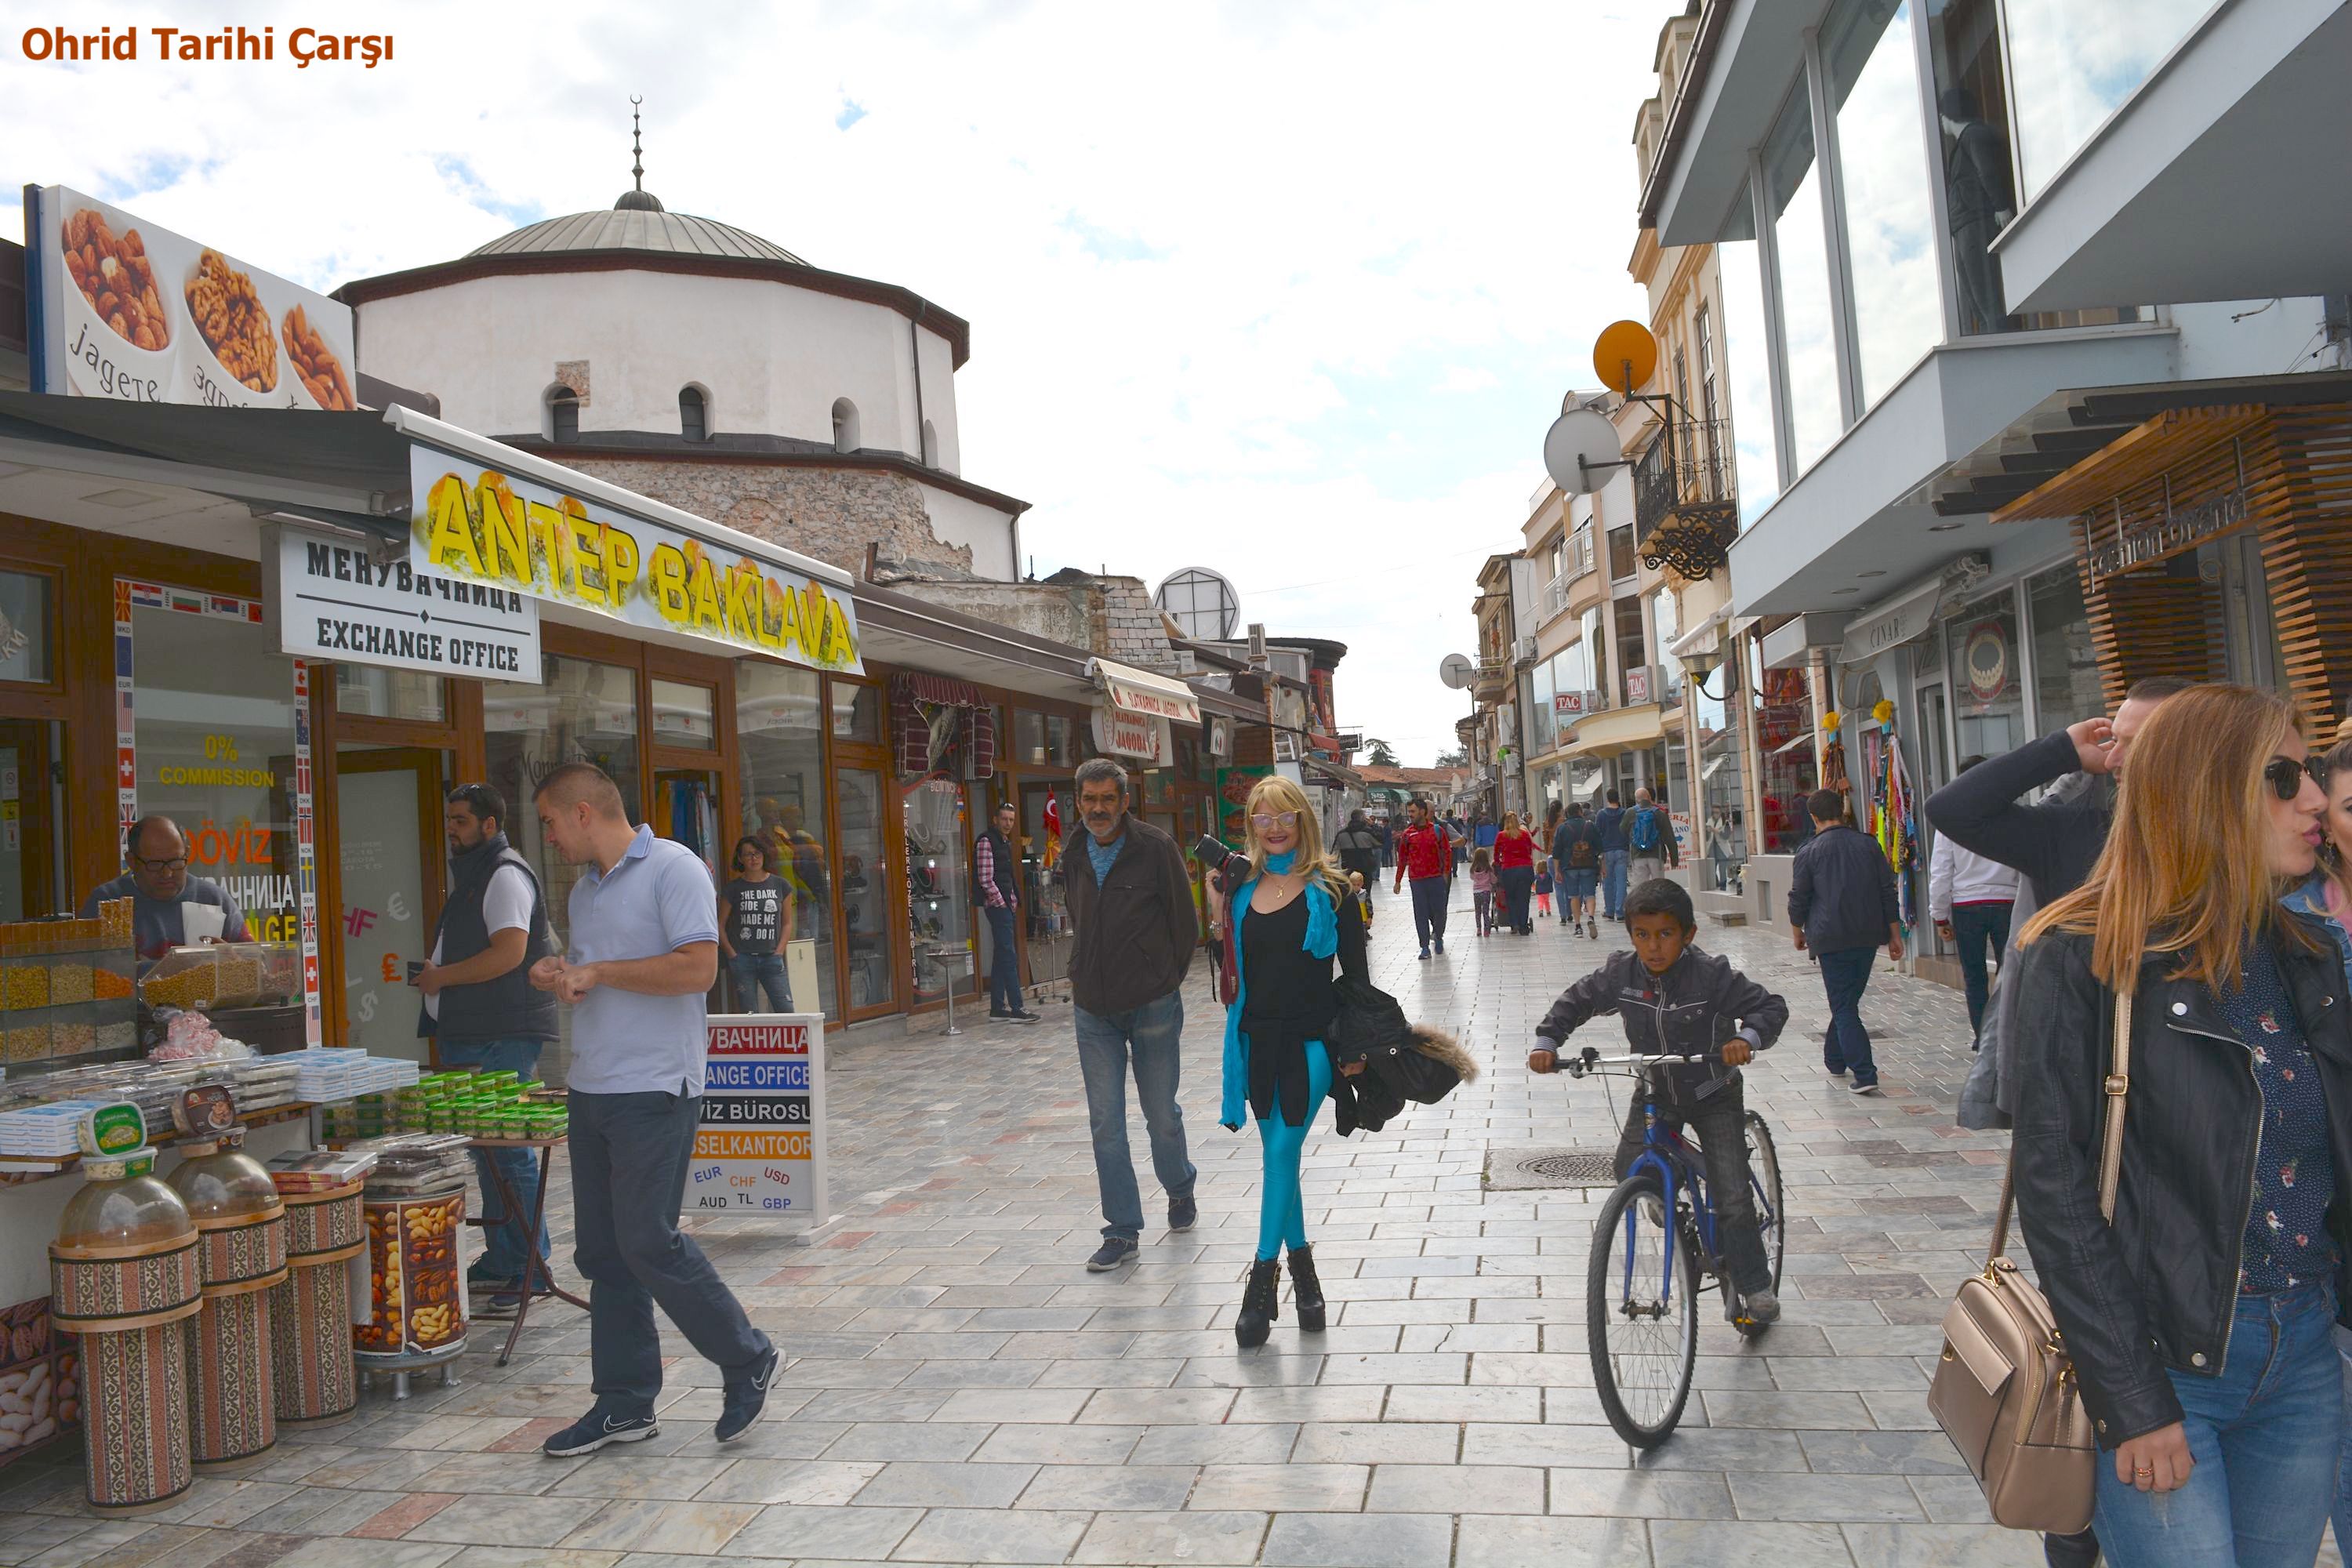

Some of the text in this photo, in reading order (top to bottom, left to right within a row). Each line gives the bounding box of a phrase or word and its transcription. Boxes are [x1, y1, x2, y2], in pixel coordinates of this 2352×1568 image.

[428, 474, 858, 664] ANTEP BAKLAVA
[317, 617, 519, 672] EXCHANGE OFFICE
[1628, 677, 1646, 696] TAÇ
[1127, 691, 1184, 719] SLATKARNICA JAGODA
[1557, 696, 1580, 710] TAÇ
[204, 735, 239, 762] 0%
[1116, 729, 1148, 753] JAGODA
[159, 765, 274, 787] COMMISSION
[740, 889, 778, 900] THE DARK
[740, 901, 758, 911] SIDE
[740, 914, 775, 925] MADE ME
[756, 928, 775, 940] DO IT
[694, 1166, 790, 1187] EUR CHF USD
[699, 1192, 791, 1209] AUD TL GBP
